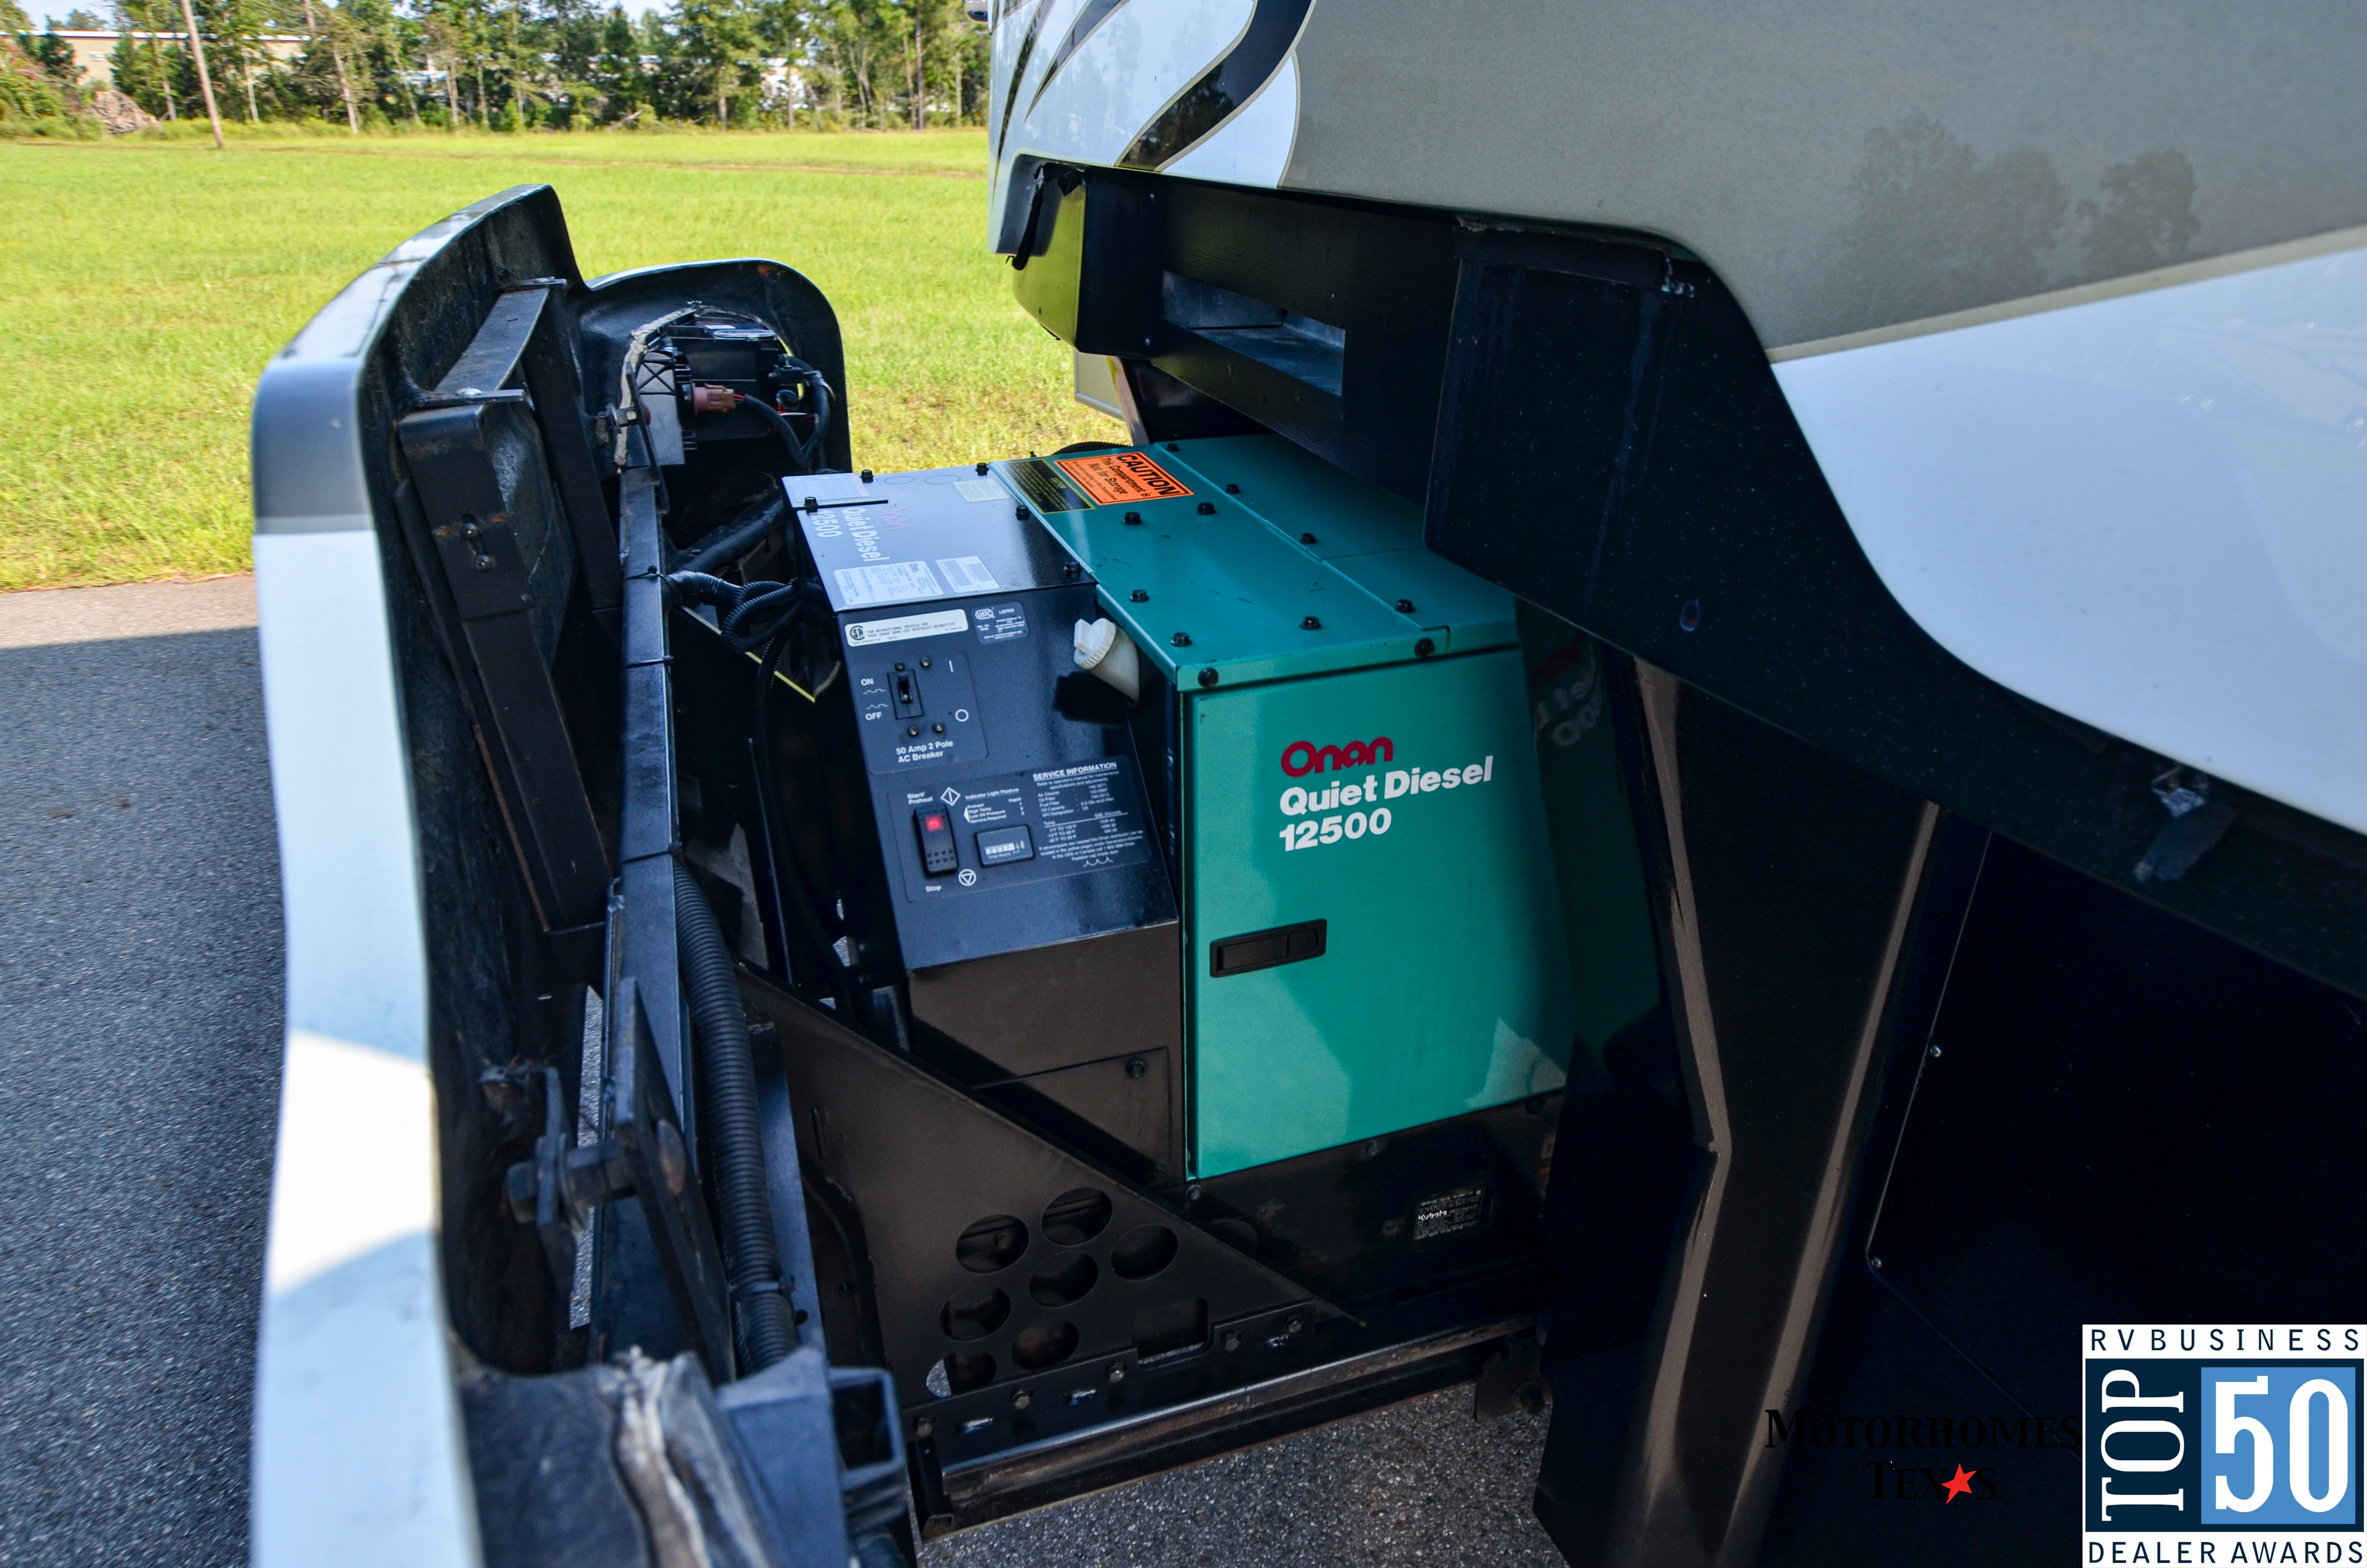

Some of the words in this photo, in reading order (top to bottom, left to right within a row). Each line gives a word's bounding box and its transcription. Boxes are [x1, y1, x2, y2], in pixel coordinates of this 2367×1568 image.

[1105, 478, 1128, 494] Storage
[1109, 466, 1145, 492] Compartment
[1116, 454, 1181, 495] CAUTION
[809, 509, 843, 537] 12500
[842, 507, 875, 531] Quiet
[851, 530, 890, 562] Diesel
[860, 677, 874, 686] ON
[865, 711, 882, 720] OFF
[908, 745, 927, 754] Amp
[935, 740, 953, 748] Pole
[912, 751, 944, 761] Breaker
[1280, 736, 1394, 777] Onan
[1033, 770, 1065, 780] SERVICE
[1066, 763, 1116, 775] INFORMATION
[1279, 775, 1377, 816] Quiet
[1384, 755, 1493, 799] Diesel
[1279, 807, 1392, 851] 12500
[1418, 1210, 1447, 1220] Kubota
